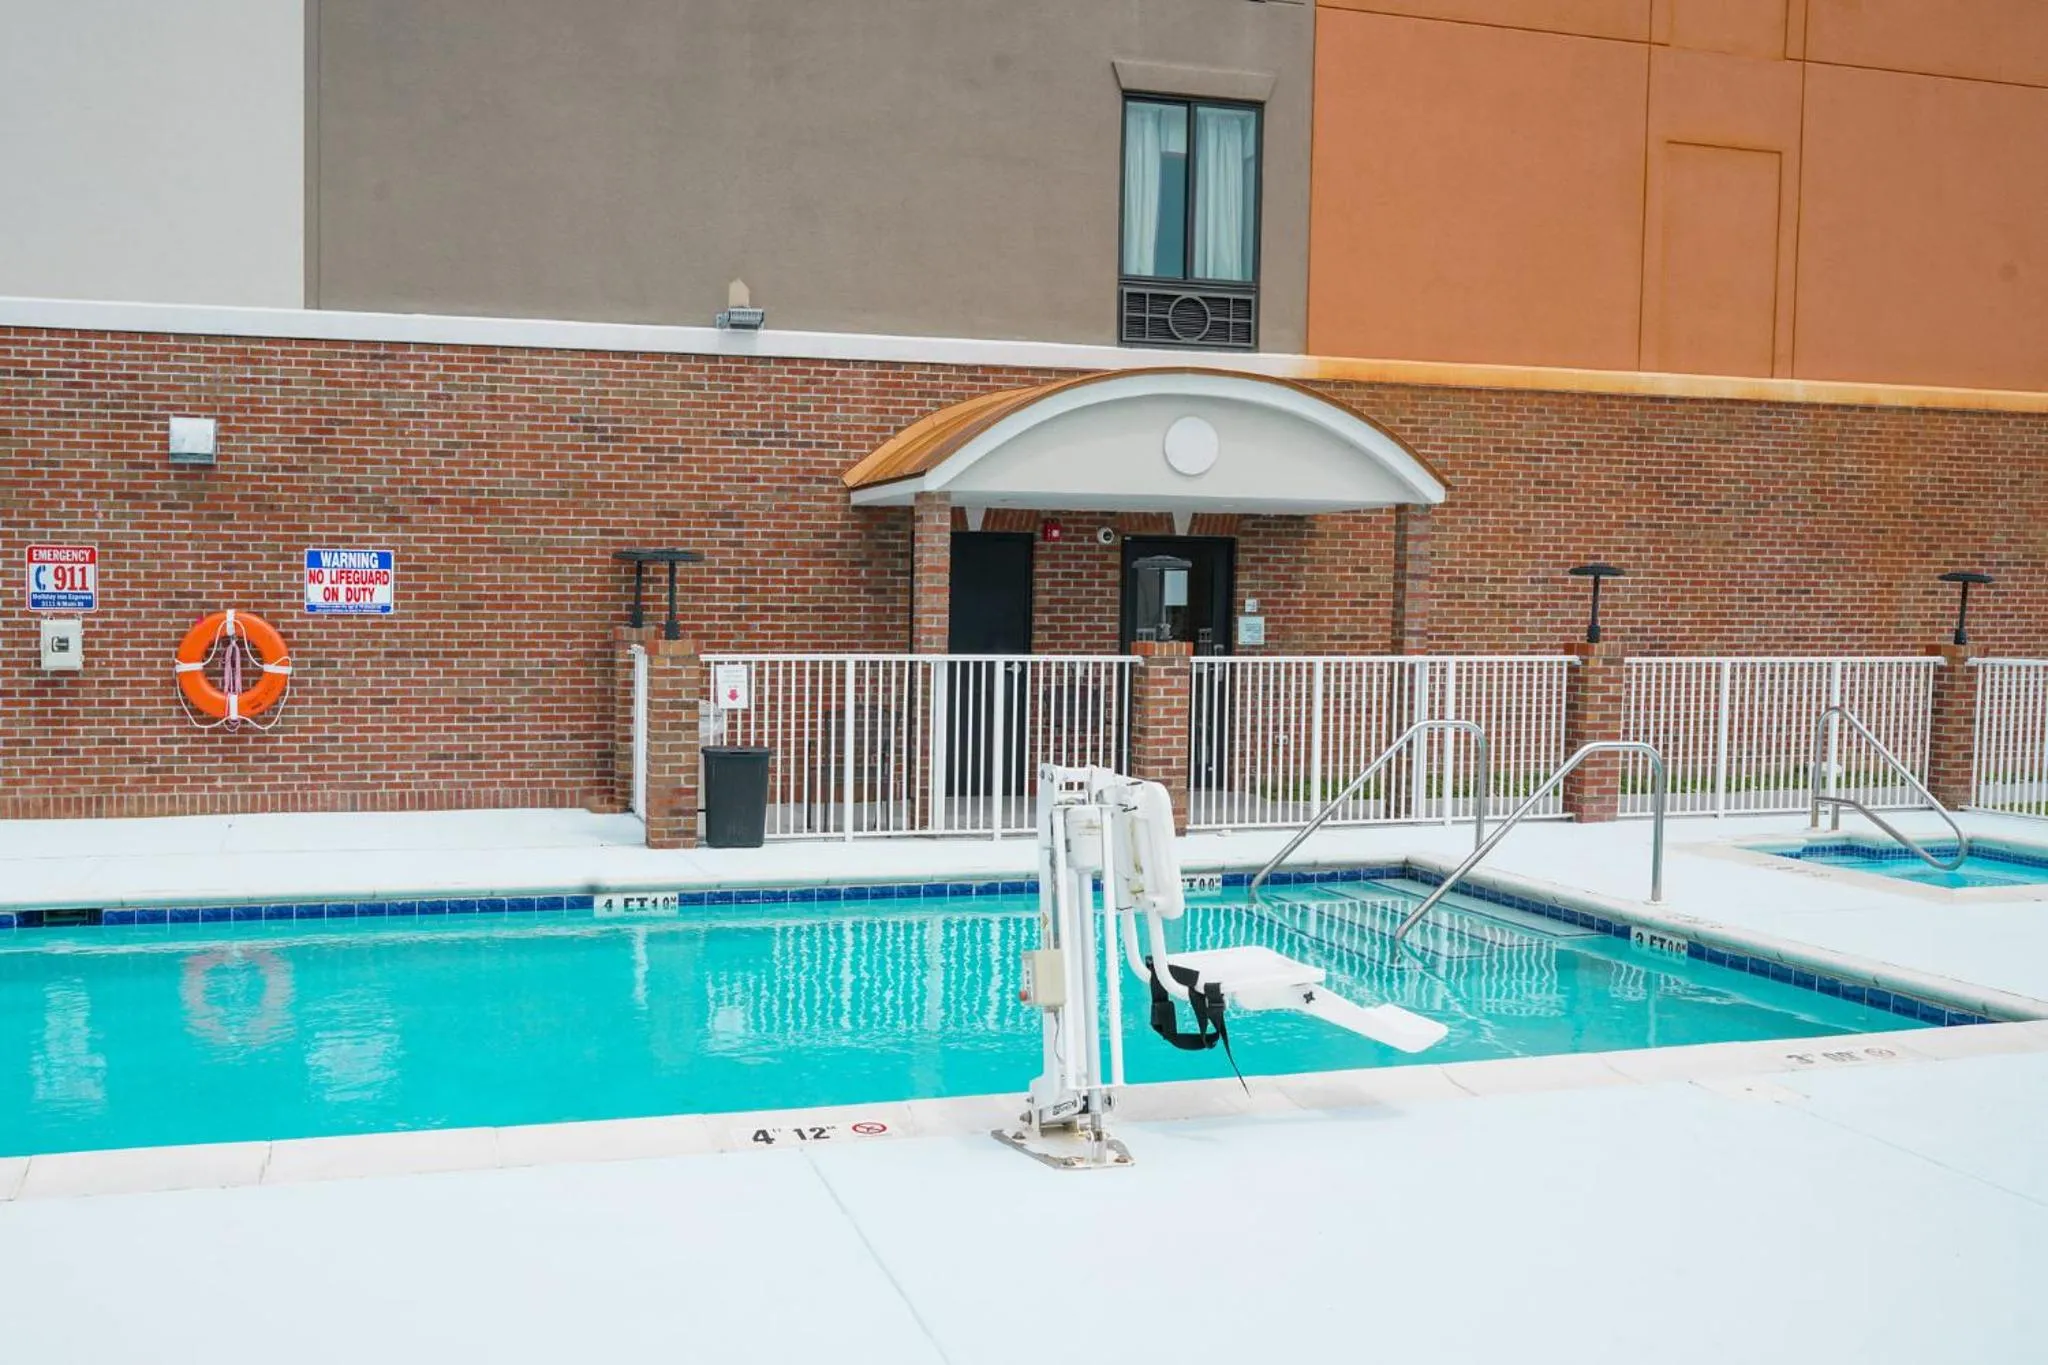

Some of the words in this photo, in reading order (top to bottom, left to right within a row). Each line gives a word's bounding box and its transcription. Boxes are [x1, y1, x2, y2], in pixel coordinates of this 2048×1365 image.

[32, 549, 91, 562] EMERGENCY
[320, 552, 379, 569] WARNING
[53, 565, 89, 591] 911
[308, 569, 324, 584] NO
[330, 570, 390, 586] LIFEGUARD
[323, 587, 339, 602] ON
[345, 587, 375, 602] DUTY
[603, 898, 613, 912] 4
